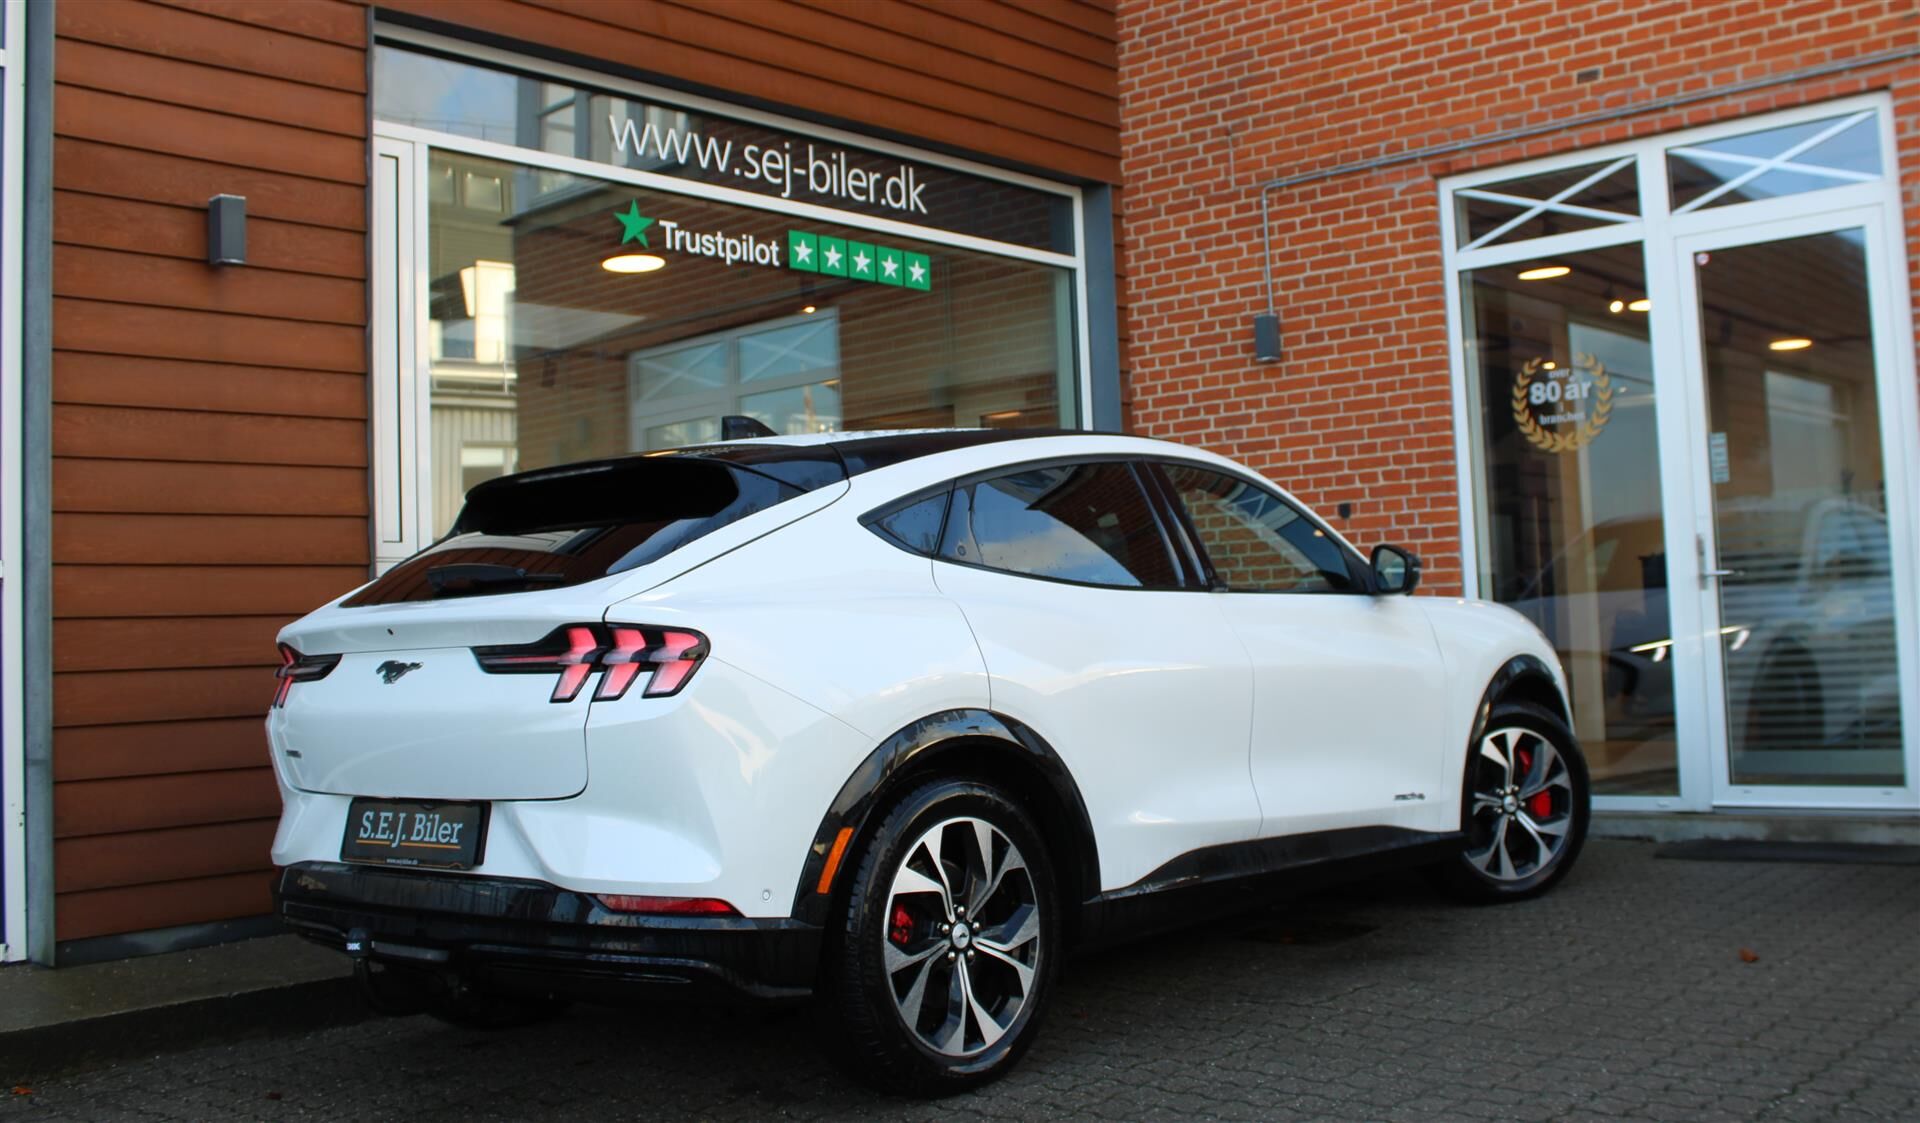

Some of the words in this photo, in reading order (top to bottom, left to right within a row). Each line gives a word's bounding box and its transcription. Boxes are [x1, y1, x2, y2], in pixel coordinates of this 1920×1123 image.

[608, 114, 929, 215] www.sej-biler.dk
[658, 219, 781, 267] Trustpilot
[1530, 380, 1561, 404] 80
[1565, 374, 1591, 400] år
[359, 811, 406, 848] S.E.J.
[411, 813, 464, 844] Biler
